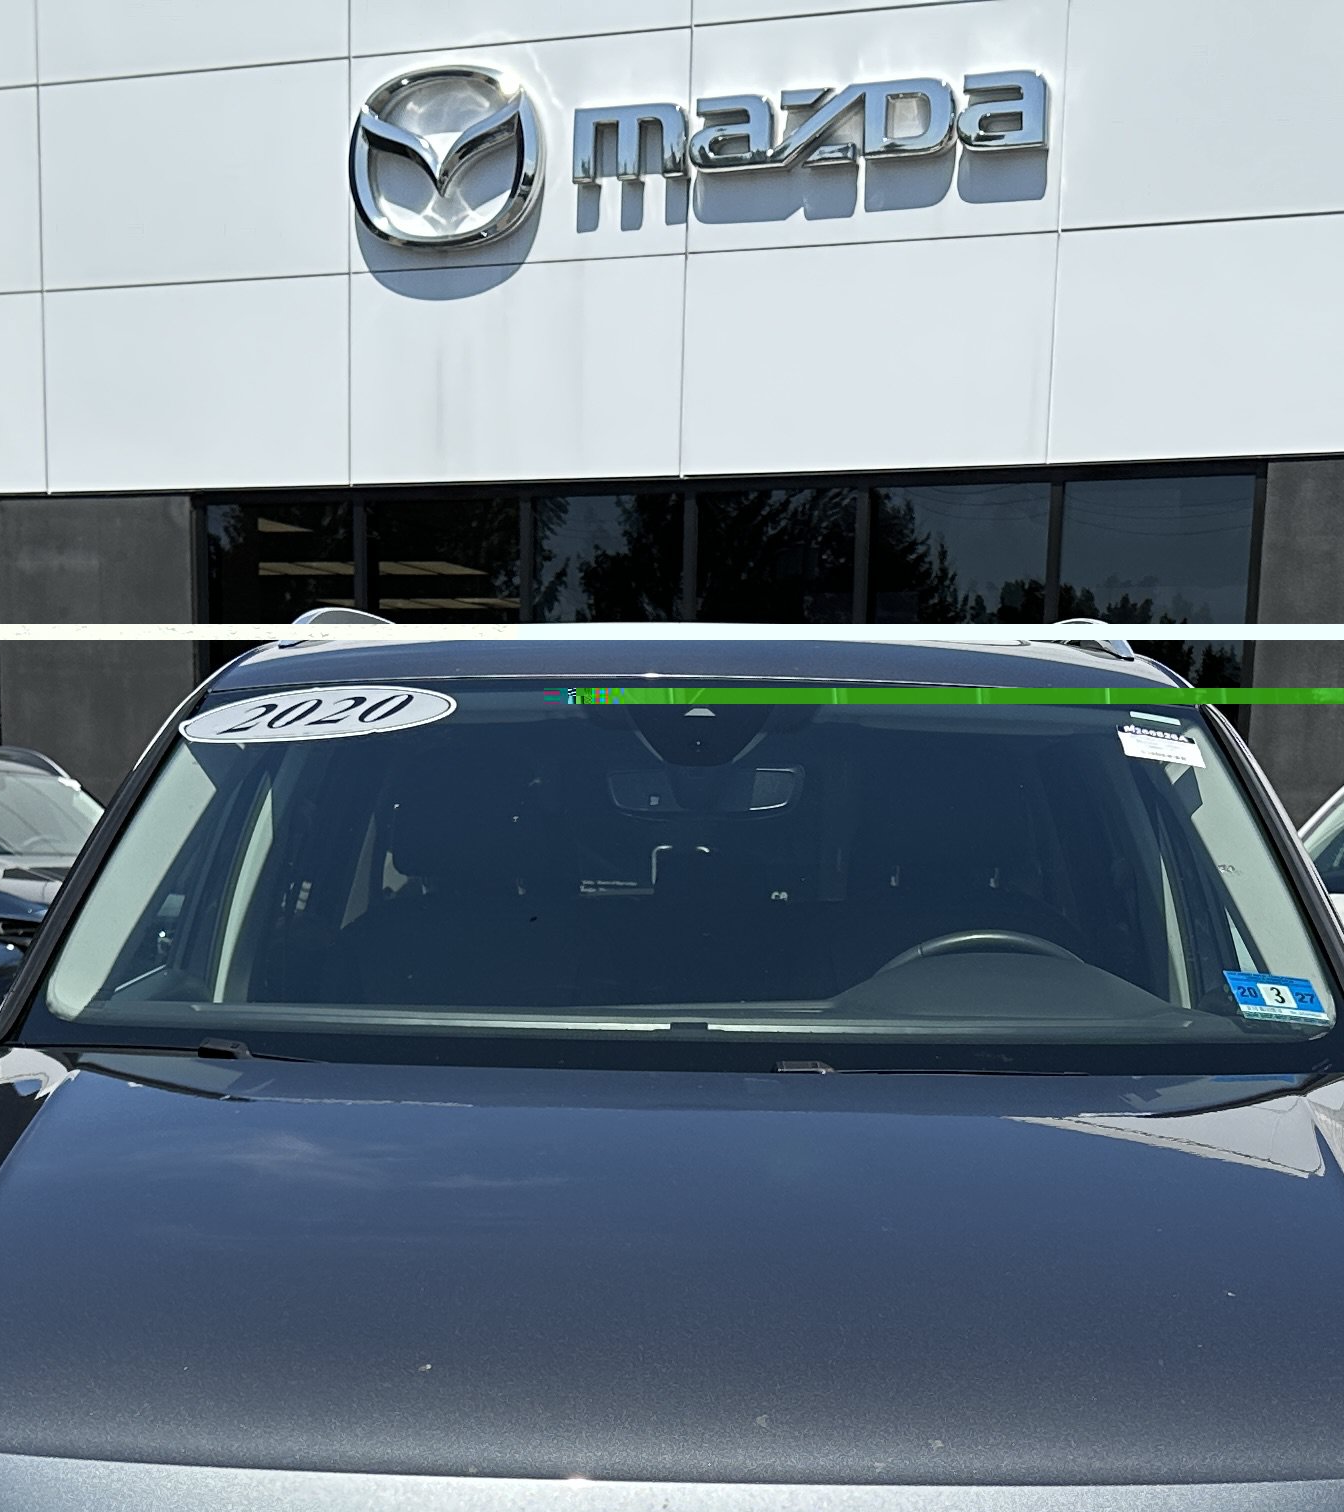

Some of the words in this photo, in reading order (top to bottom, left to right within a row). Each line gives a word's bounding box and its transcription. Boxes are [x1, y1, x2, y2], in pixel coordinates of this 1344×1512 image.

[216, 694, 414, 735] 2020
[1238, 985, 1258, 999] 20
[1270, 986, 1286, 1004] 3
[1295, 992, 1315, 1004] 27
